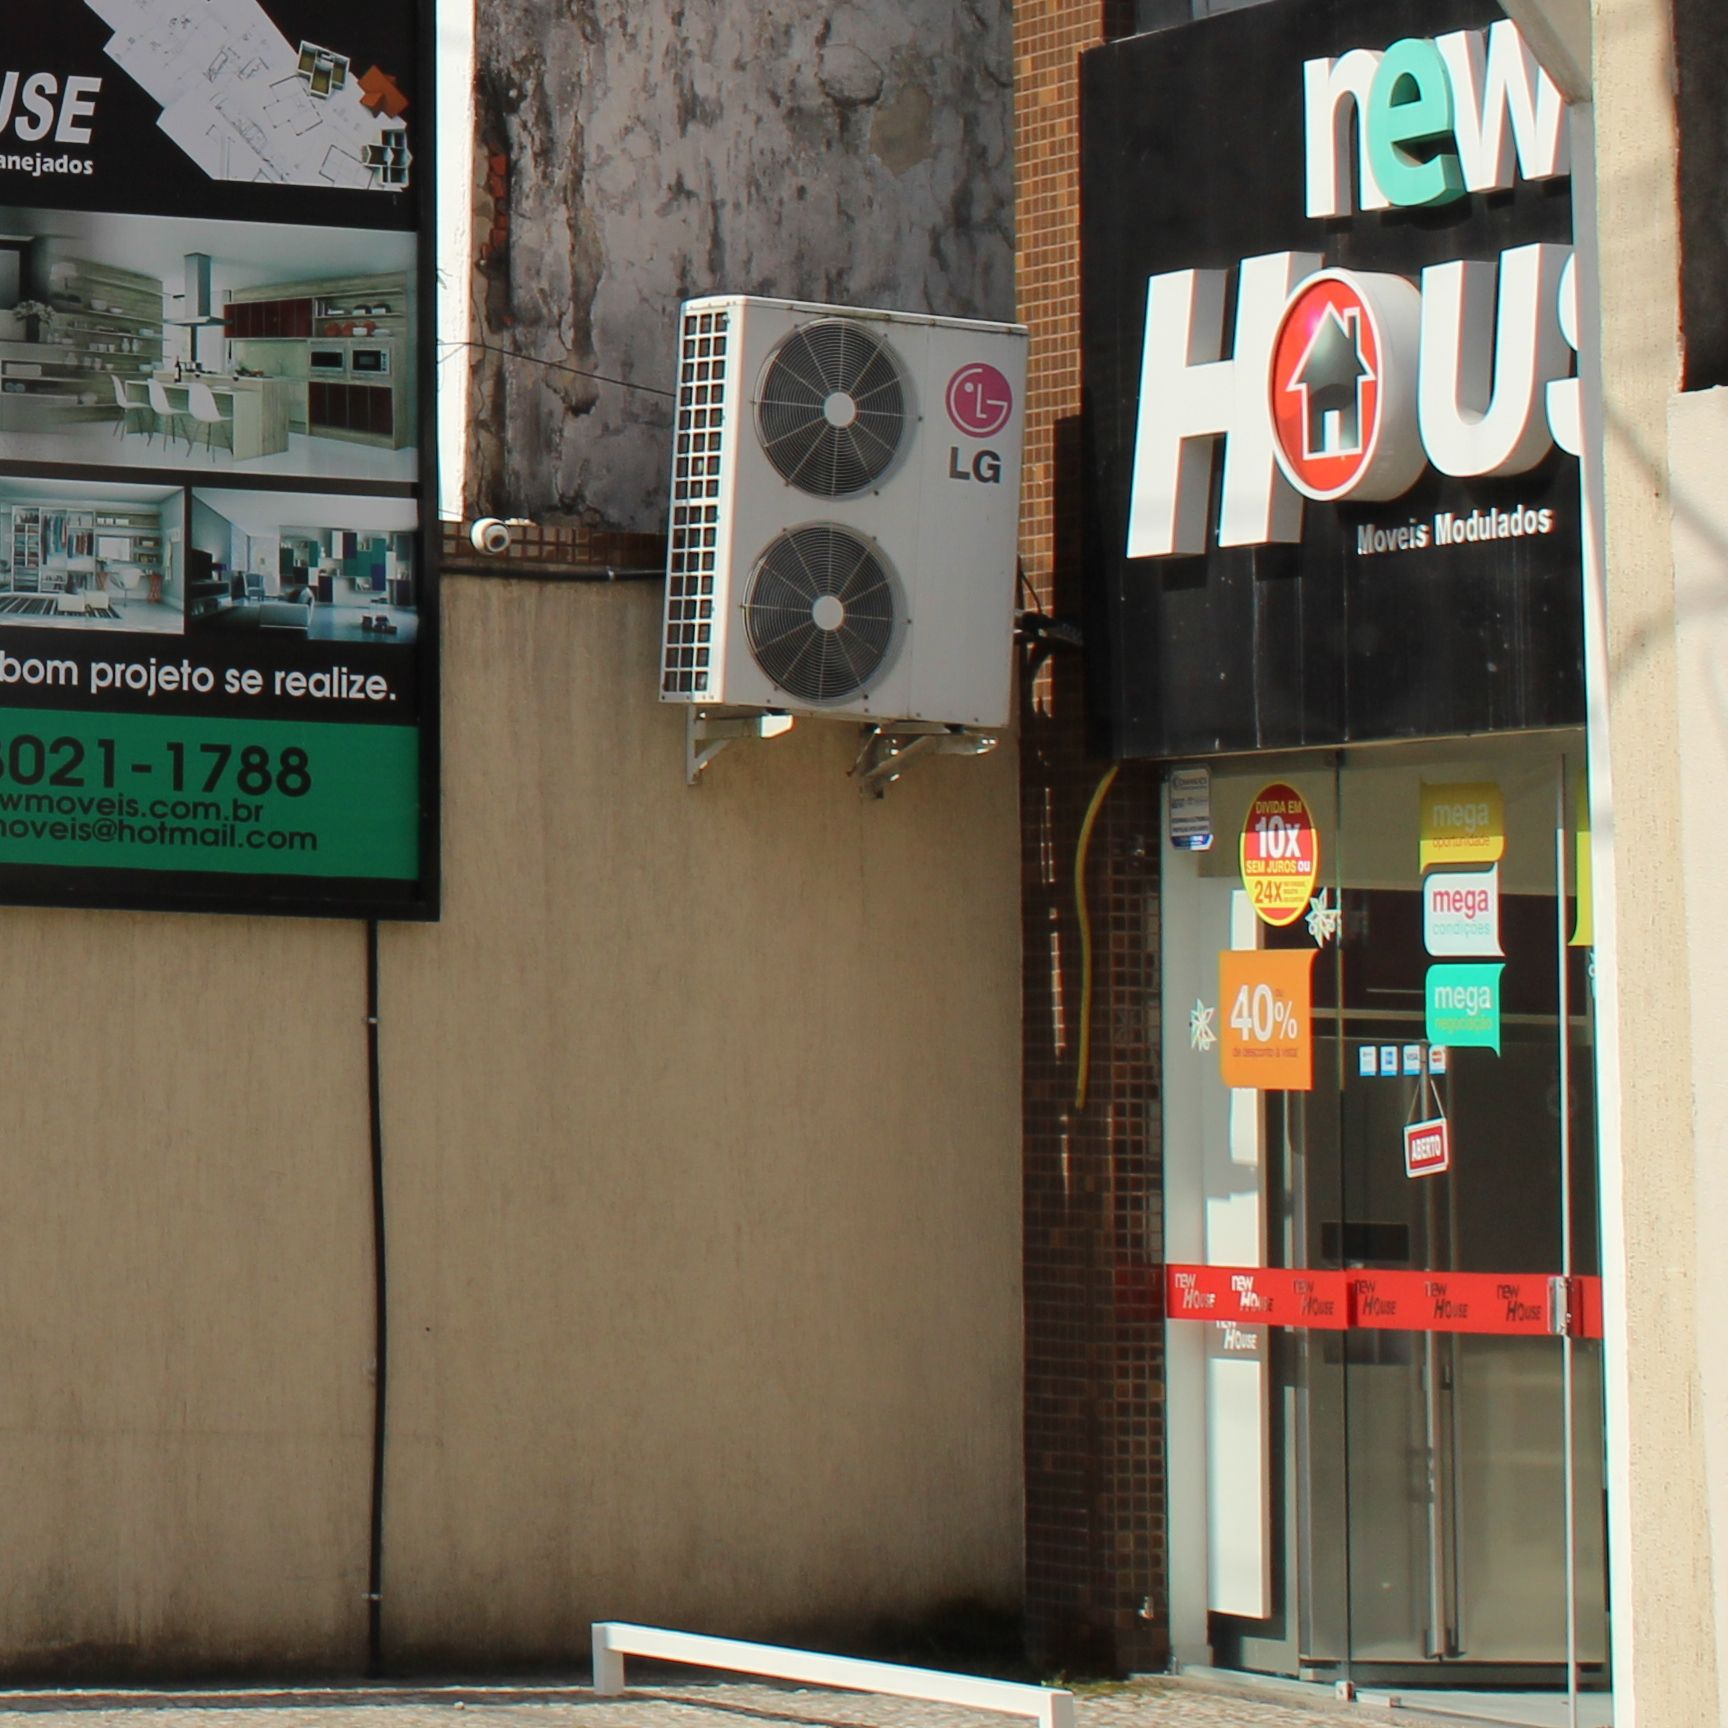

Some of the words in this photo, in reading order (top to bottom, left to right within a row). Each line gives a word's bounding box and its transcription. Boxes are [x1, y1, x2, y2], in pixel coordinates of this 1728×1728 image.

[1303, 19, 1572, 219] new
[948, 445, 1003, 485] LG
[1357, 517, 1431, 556] Moveis
[1435, 503, 1554, 546] Modulados
[90, 658, 215, 697] projeto
[224, 668, 264, 696] se
[274, 666, 397, 701] realize.
[1255, 800, 1286, 815] DIVIDA
[1287, 801, 1303, 814] EM
[1432, 802, 1490, 832] mega
[1246, 859, 1265, 874] SEM
[1266, 859, 1297, 874] JUROS
[1432, 887, 1490, 920] mega
[1230, 983, 1298, 1043] 40%
[1434, 984, 1492, 1016] mega
[1410, 1133, 1442, 1162] ABERTO
[1230, 1274, 1254, 1292] new
